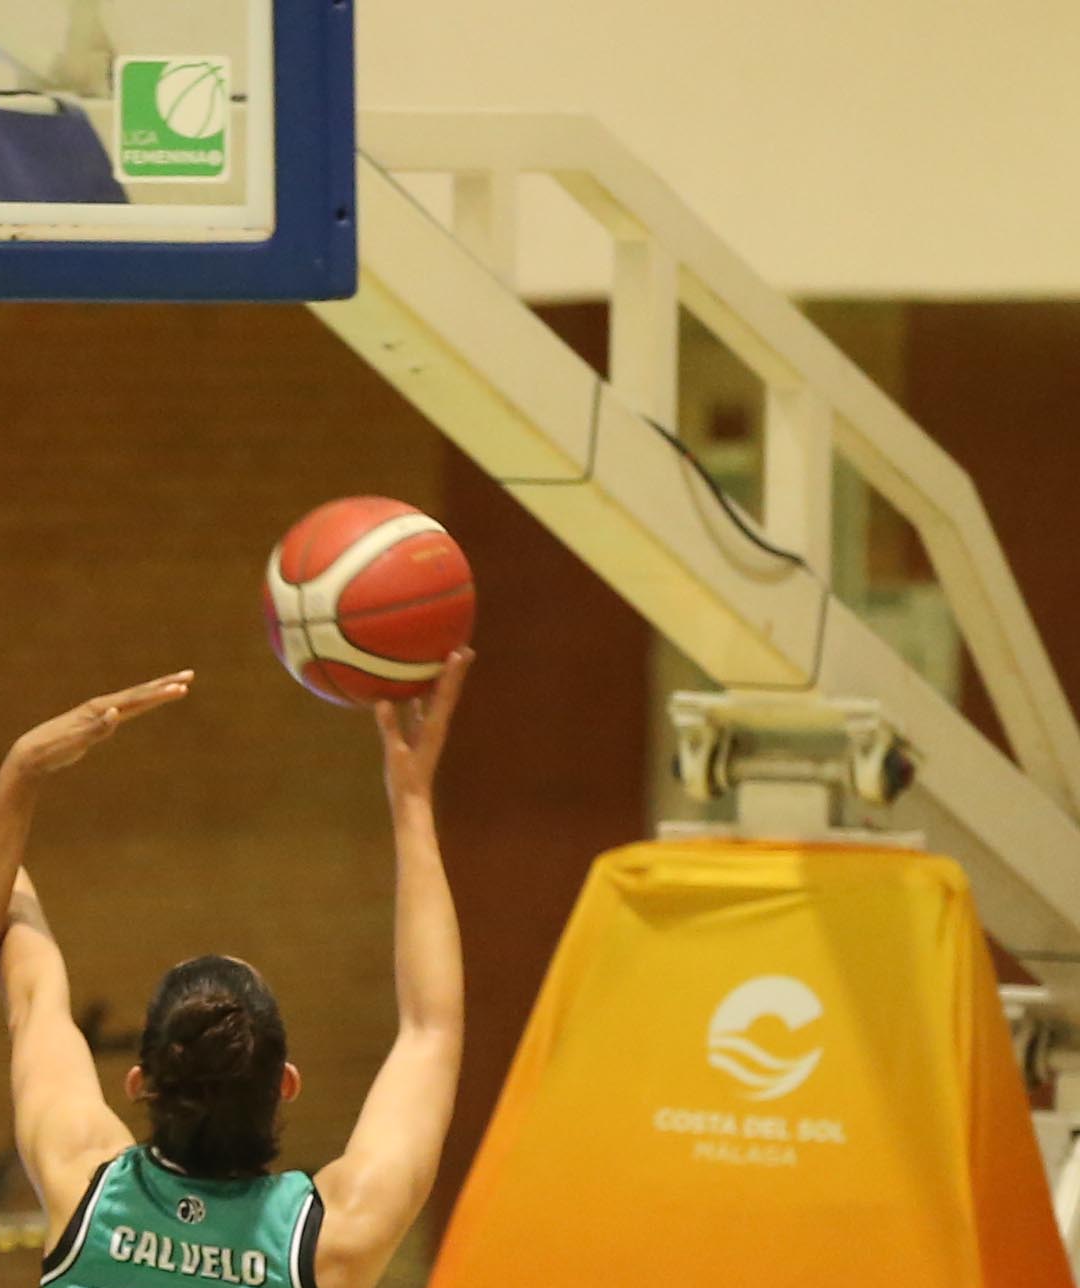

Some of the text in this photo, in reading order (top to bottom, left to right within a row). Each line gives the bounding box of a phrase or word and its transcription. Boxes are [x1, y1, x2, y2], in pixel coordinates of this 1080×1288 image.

[653, 1107, 846, 1144] COSTA DEL SOL
[110, 1225, 267, 1286] GALVELO
